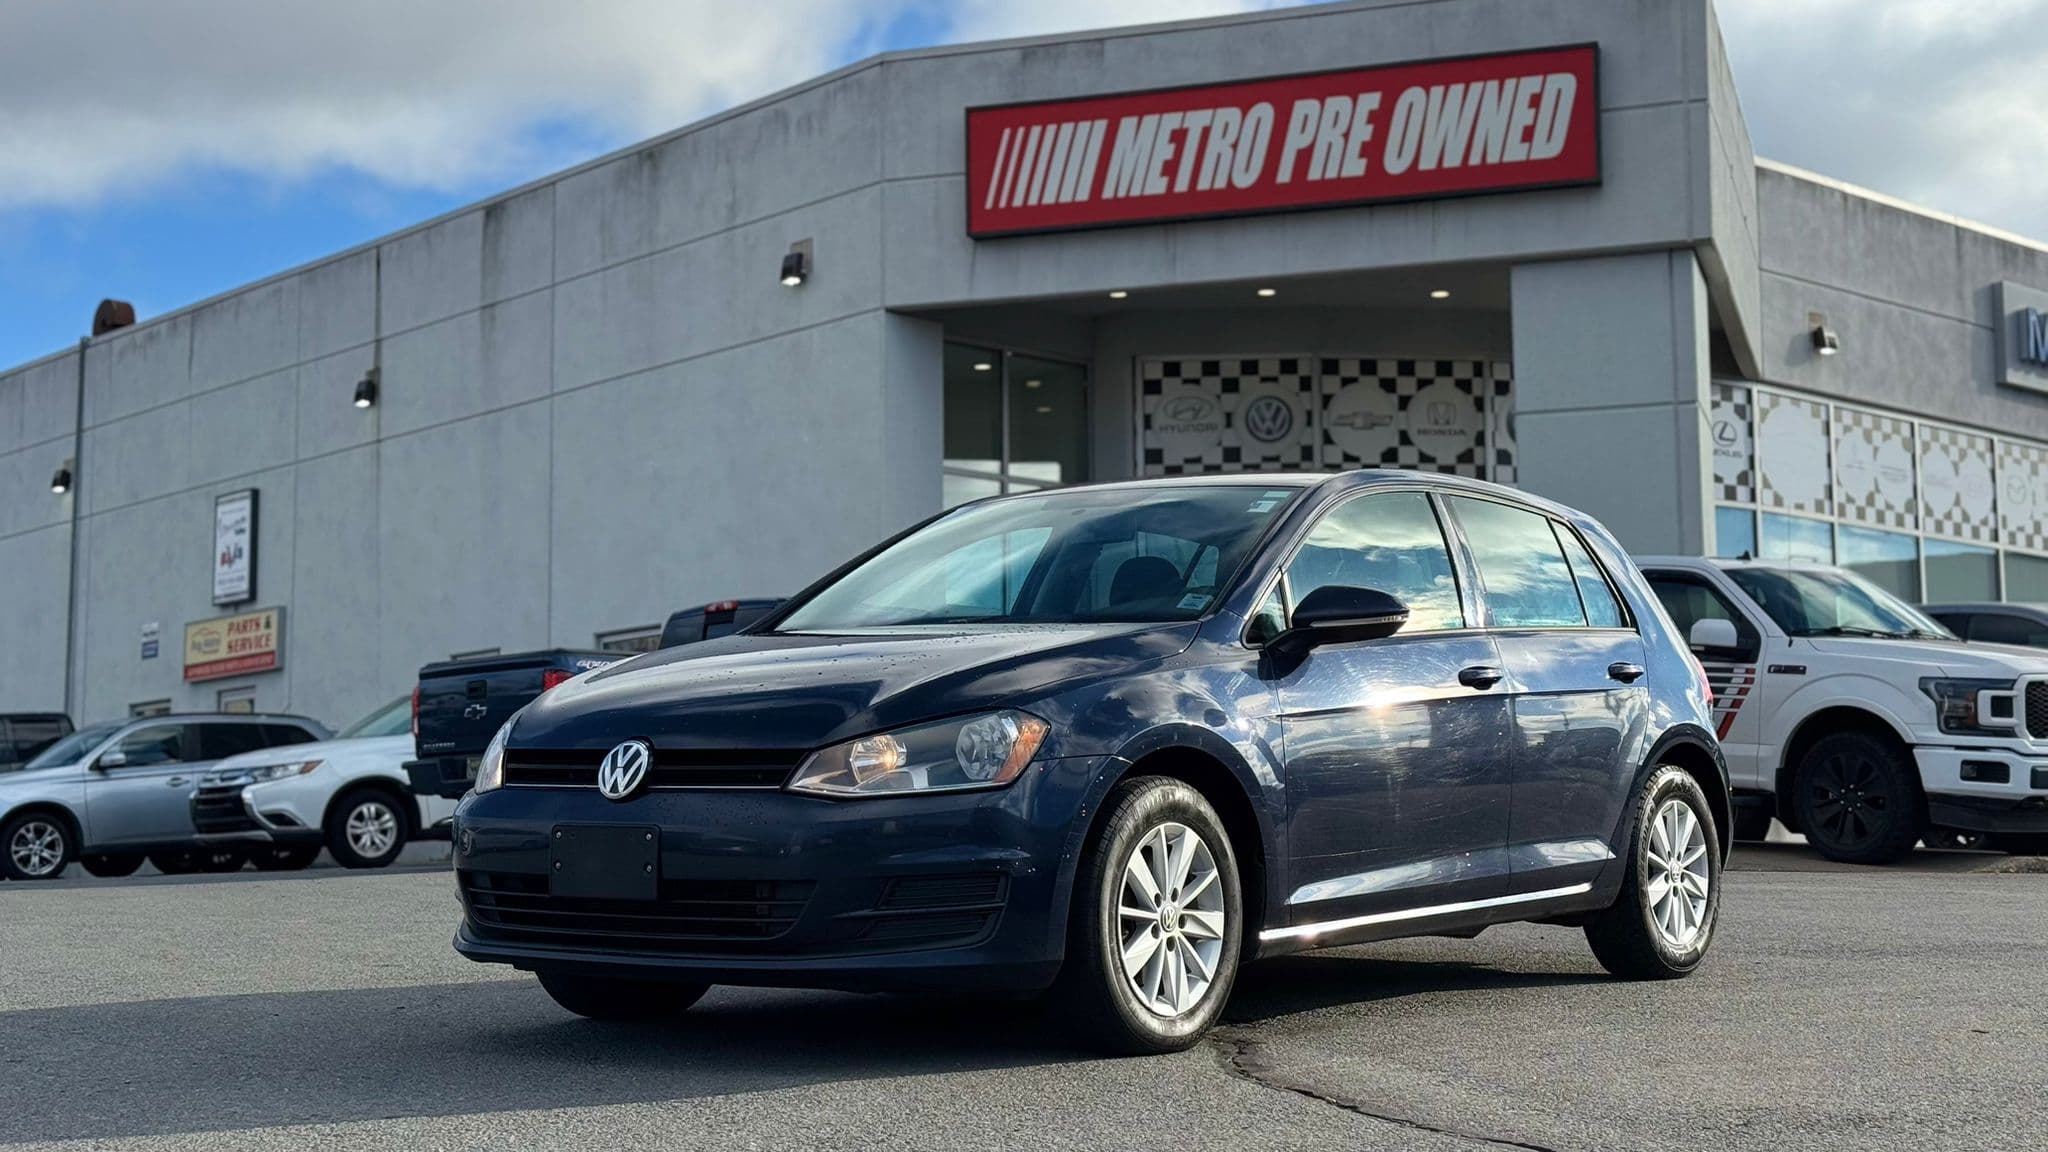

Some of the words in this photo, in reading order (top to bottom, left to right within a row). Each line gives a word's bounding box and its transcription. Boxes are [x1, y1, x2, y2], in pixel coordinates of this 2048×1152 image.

[1101, 102, 1275, 200] METRO
[1276, 91, 1382, 184] PRE
[1383, 72, 1577, 175] OWNED
[1159, 423, 1219, 433] HYUNDAI
[1416, 427, 1467, 437] HONDA
[227, 617, 261, 636] PARTS
[227, 633, 272, 654] SERVICE
